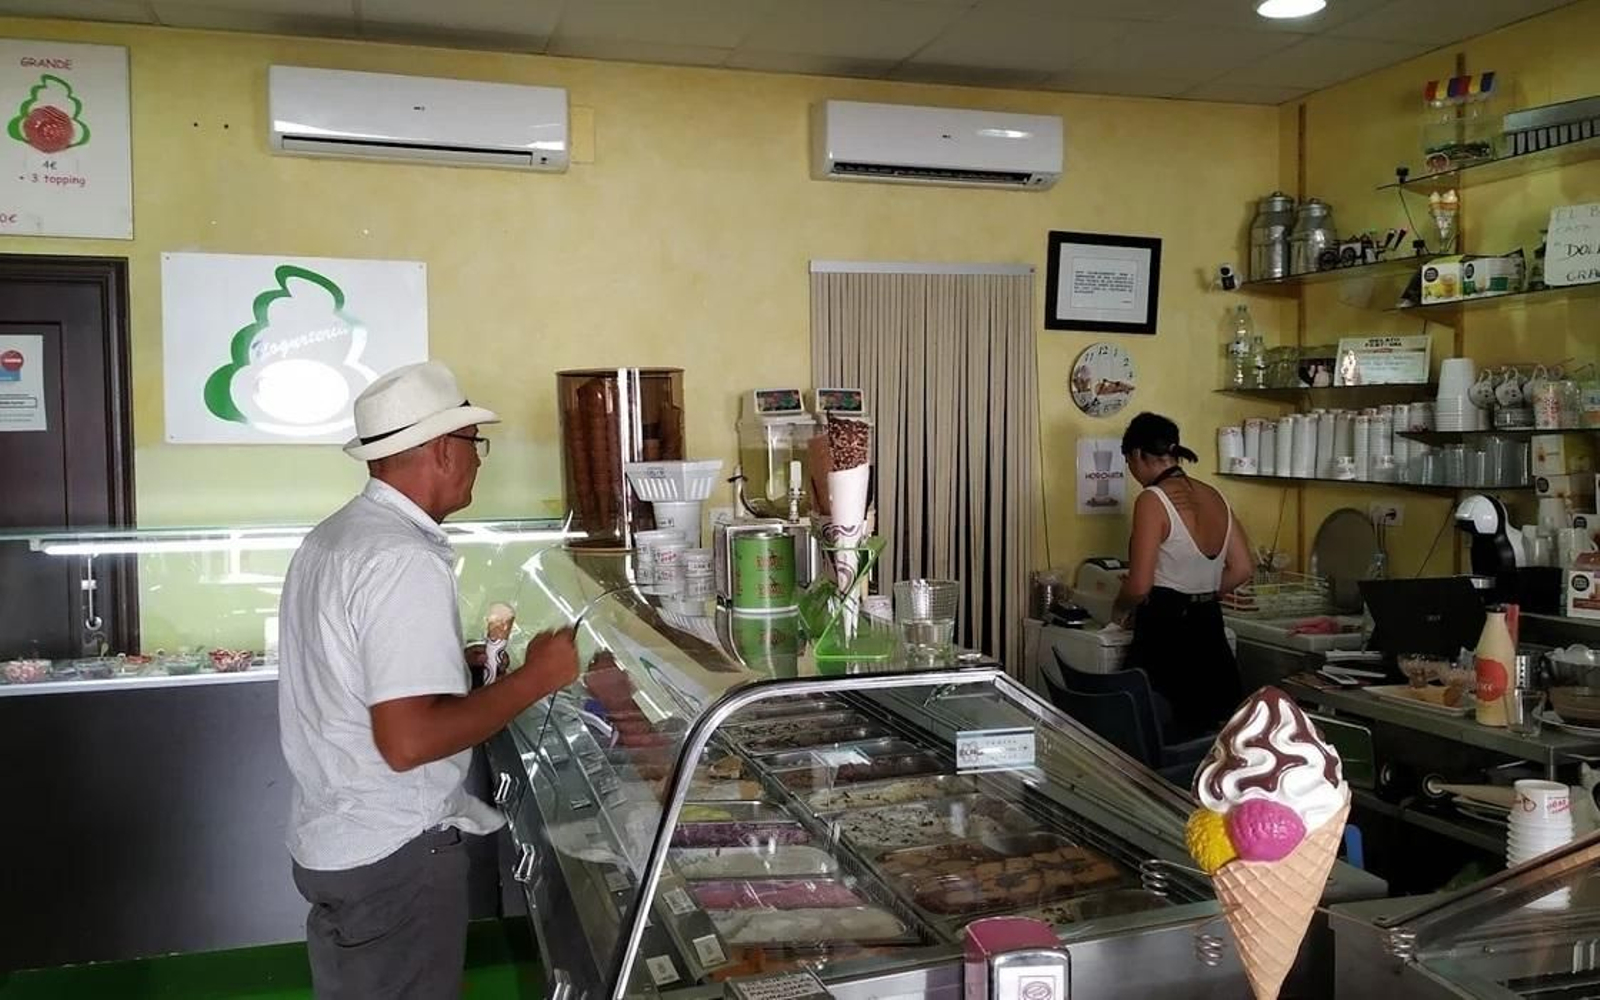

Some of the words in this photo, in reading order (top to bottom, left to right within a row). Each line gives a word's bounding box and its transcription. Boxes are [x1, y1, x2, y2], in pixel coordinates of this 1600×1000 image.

[20, 56, 73, 70] GRANDE
[31, 173, 39, 183] 3
[44, 173, 86, 187] topping
